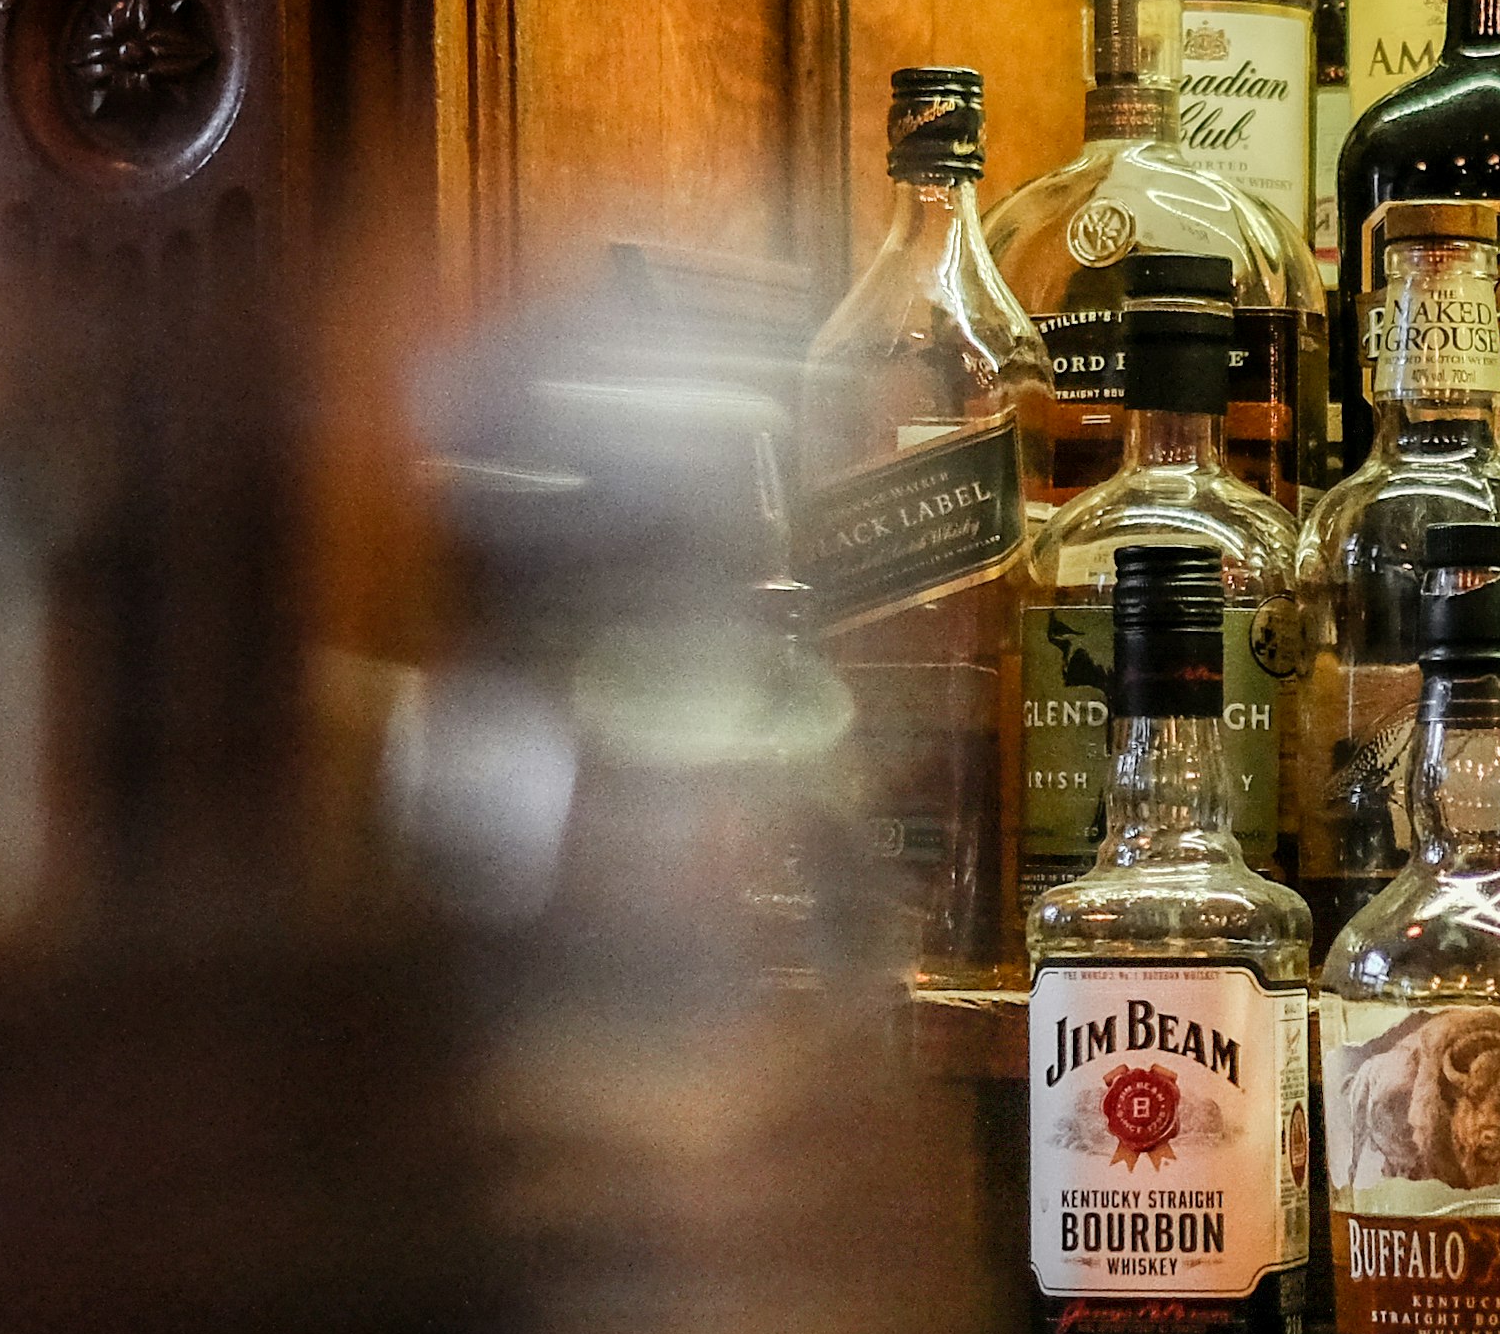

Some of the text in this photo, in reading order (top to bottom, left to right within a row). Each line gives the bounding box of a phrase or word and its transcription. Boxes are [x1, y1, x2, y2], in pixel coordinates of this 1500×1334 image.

[1179, 59, 1289, 102] nadian
[1249, 176, 1293, 192] WHISKY
[1429, 289, 1458, 300] THE
[1390, 300, 1492, 326] NAKED
[1383, 326, 1500, 355] GROUSE
[1055, 388, 1101, 400] TRAIGHT
[899, 480, 992, 529] LABEL
[1027, 770, 1088, 790] IRISH
[1045, 999, 1243, 1090] JIM BEAM
[1133, 1097, 1151, 1119] B
[1060, 1189, 1224, 1209] KENTUCKY STRAIGHT
[1060, 1212, 1225, 1253] BOURBON
[1347, 1218, 1466, 1282] BUFFALO
[1106, 1257, 1178, 1276] WHISKEY
[1371, 1310, 1460, 1326] STRAIGHT
